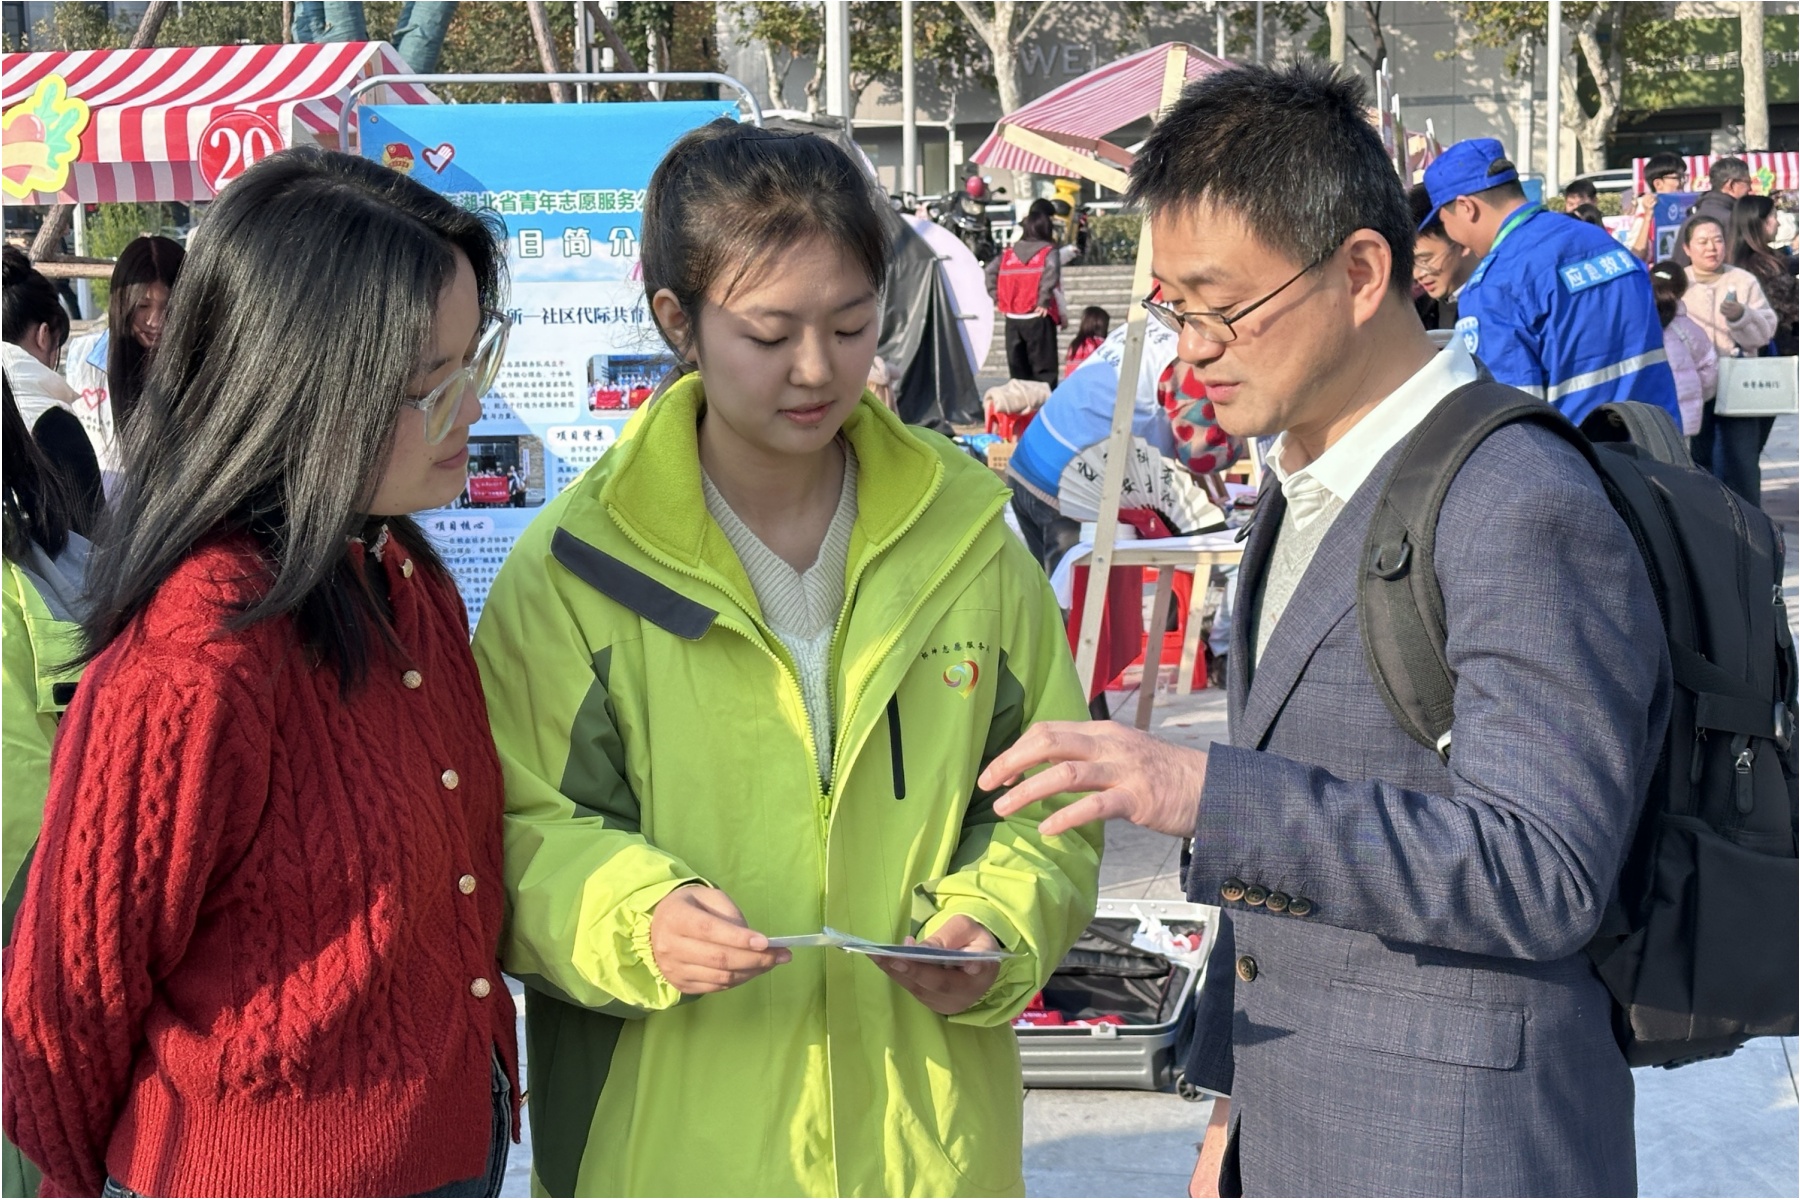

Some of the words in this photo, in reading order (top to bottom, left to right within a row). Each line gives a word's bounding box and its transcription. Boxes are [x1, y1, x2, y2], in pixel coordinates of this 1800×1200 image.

[1564, 250, 1636, 289] 应急救援
[556, 429, 604, 441] 项目背景
[435, 521, 485, 531] 项目核心
